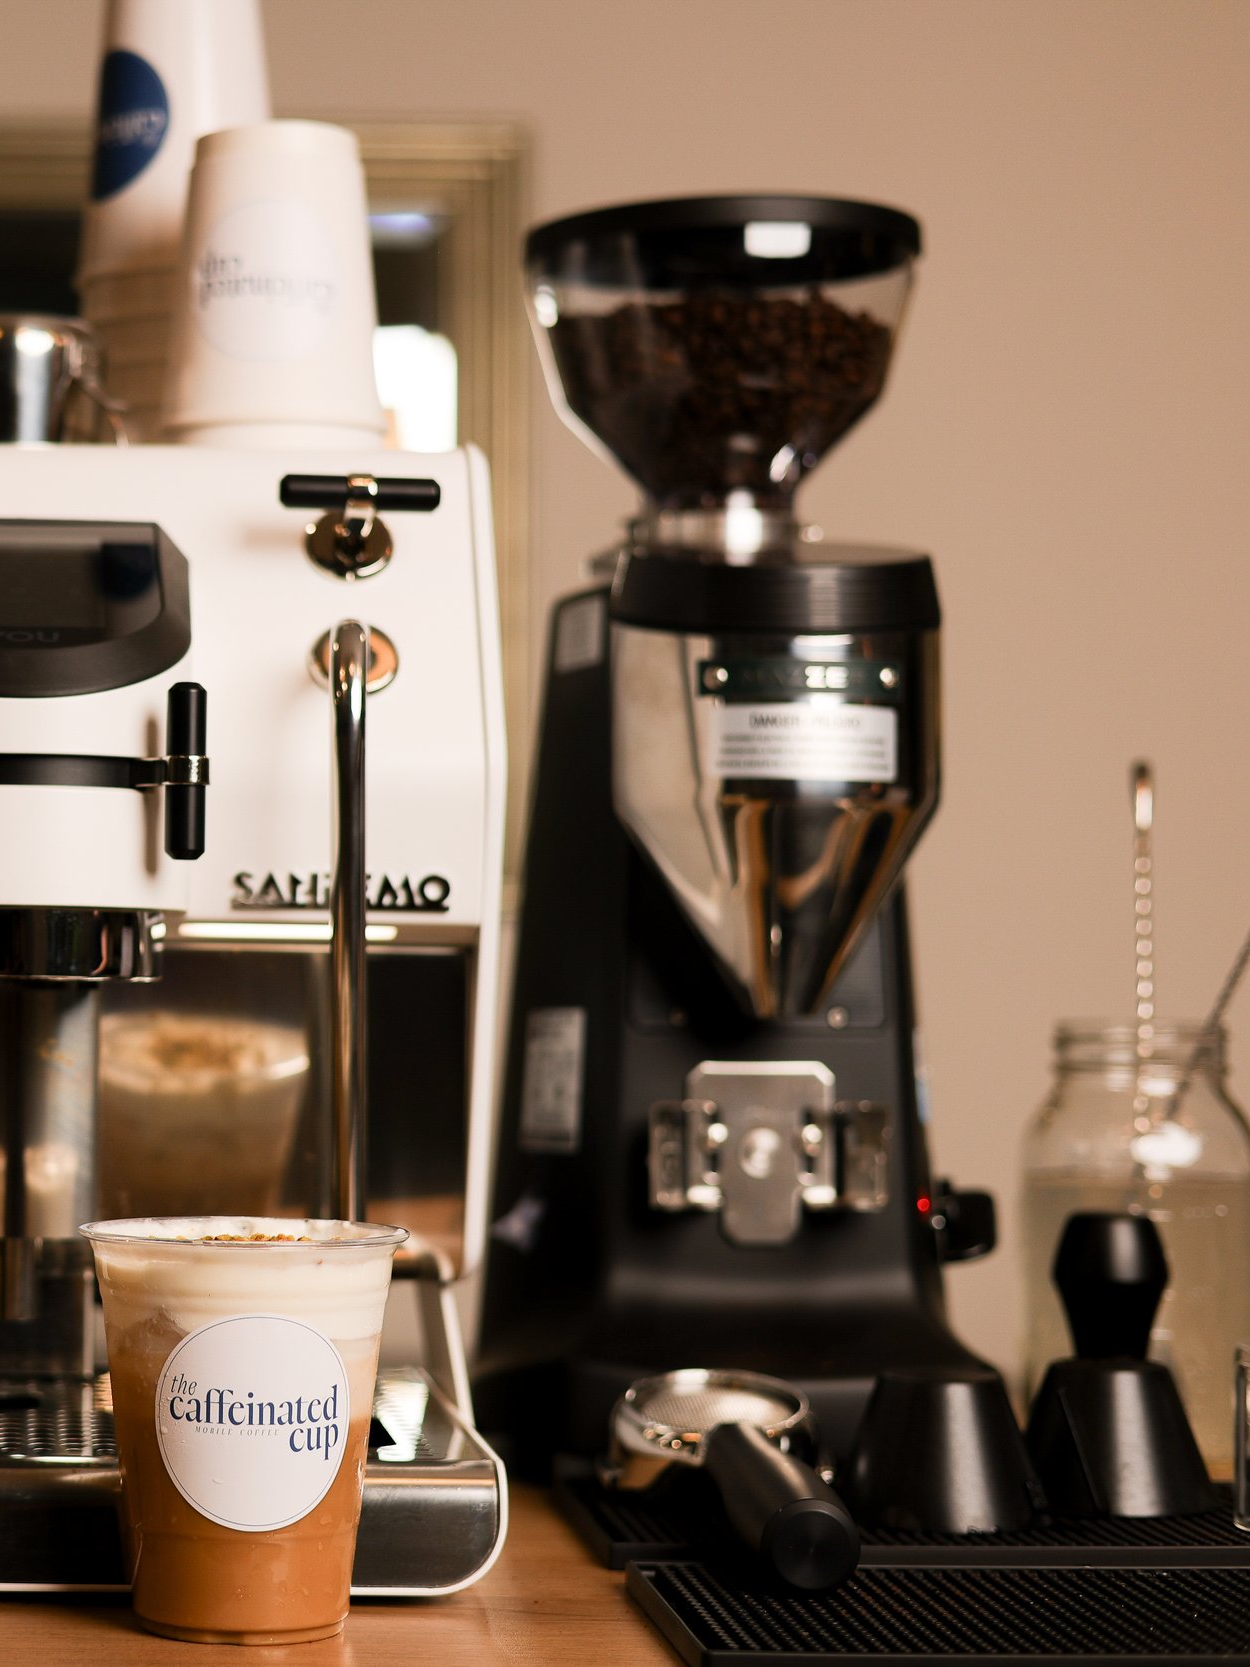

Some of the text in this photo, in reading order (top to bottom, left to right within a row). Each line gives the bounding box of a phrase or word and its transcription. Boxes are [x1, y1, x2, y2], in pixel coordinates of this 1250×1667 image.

[231, 871, 451, 907] SANMO
[170, 1373, 198, 1396] the
[169, 1384, 338, 1426] caffeinated
[194, 1425, 280, 1437] MOBILE COFFEE
[289, 1423, 339, 1461] cup
